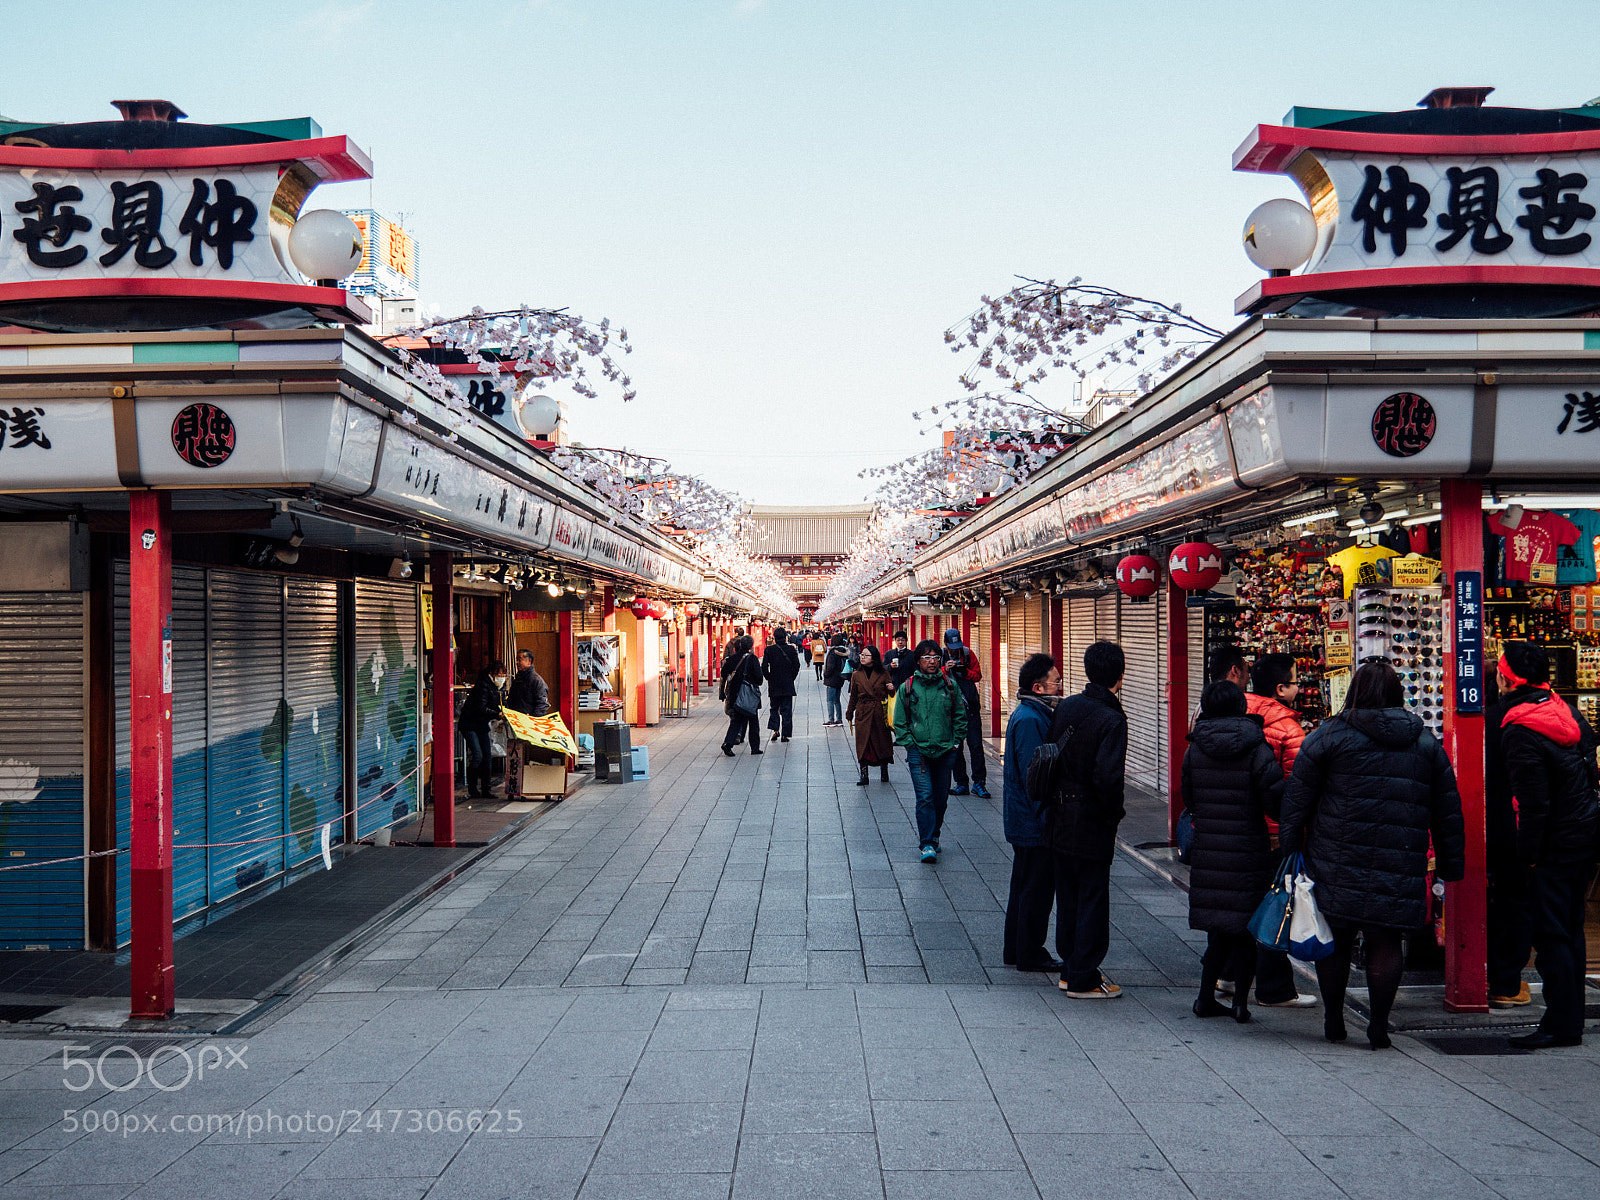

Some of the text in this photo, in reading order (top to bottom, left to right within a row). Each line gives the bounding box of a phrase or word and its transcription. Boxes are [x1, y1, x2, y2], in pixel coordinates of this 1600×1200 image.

[1352, 165, 1597, 257] 仲見世
[1463, 603, 1475, 677] 浅草一丁目
[1461, 688, 1478, 703] 18
